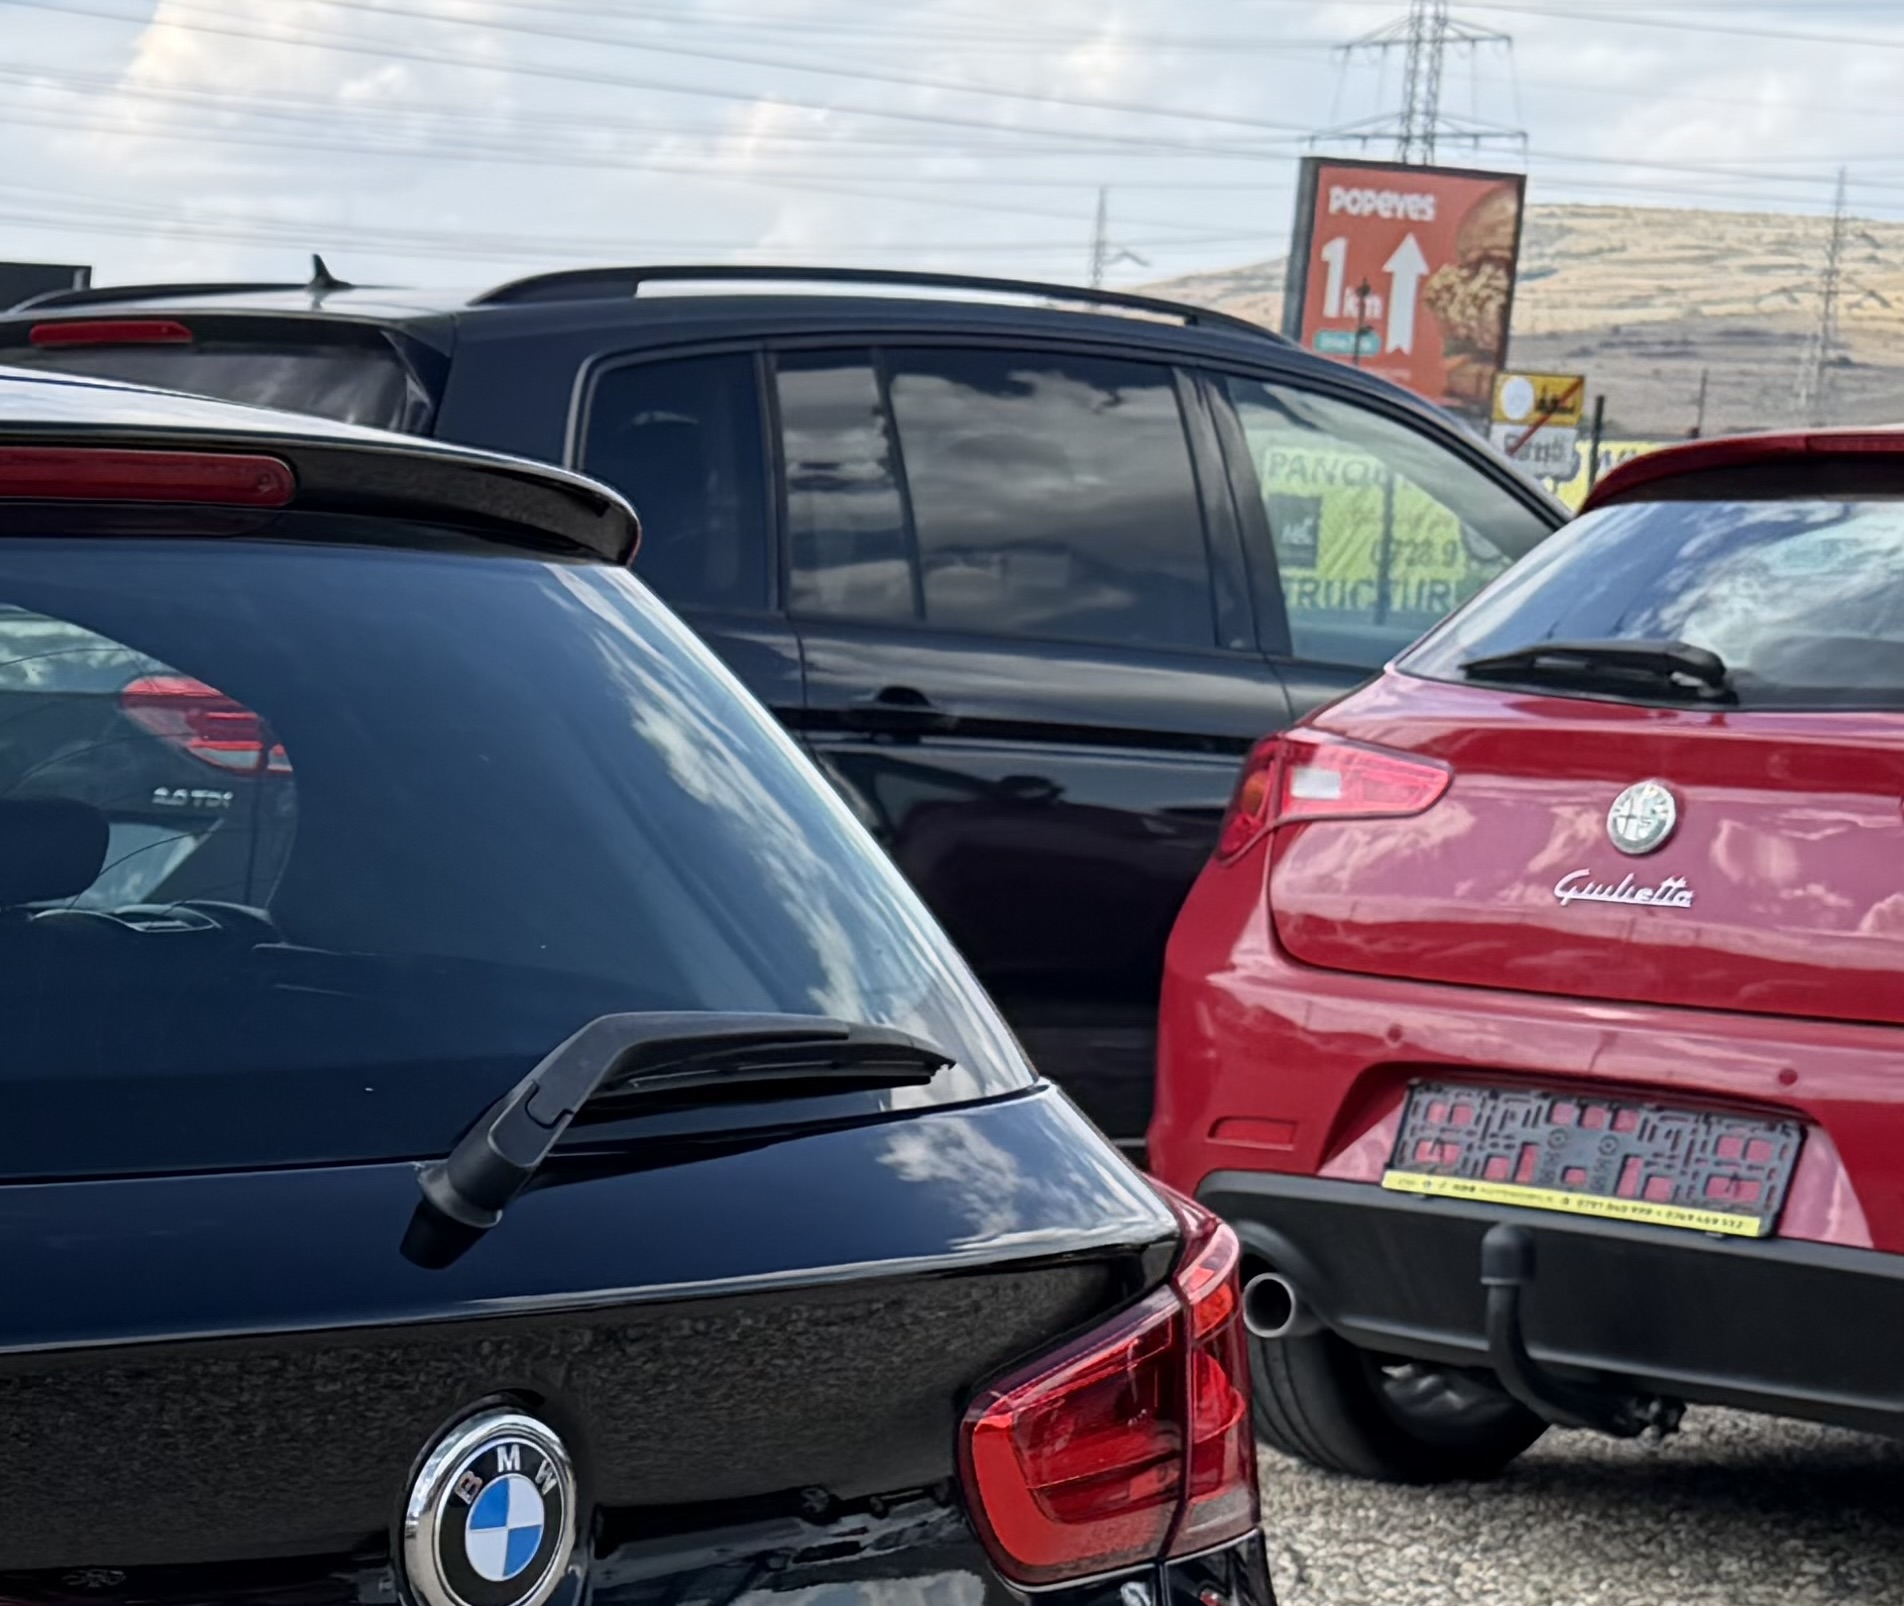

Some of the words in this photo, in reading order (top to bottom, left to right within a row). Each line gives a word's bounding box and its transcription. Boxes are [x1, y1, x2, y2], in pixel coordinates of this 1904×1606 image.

[1329, 185, 1436, 222] POPEYES
[1321, 235, 1349, 319] 1
[1554, 868, 1694, 908] Giulietta
[454, 1443, 559, 1505] BMW
